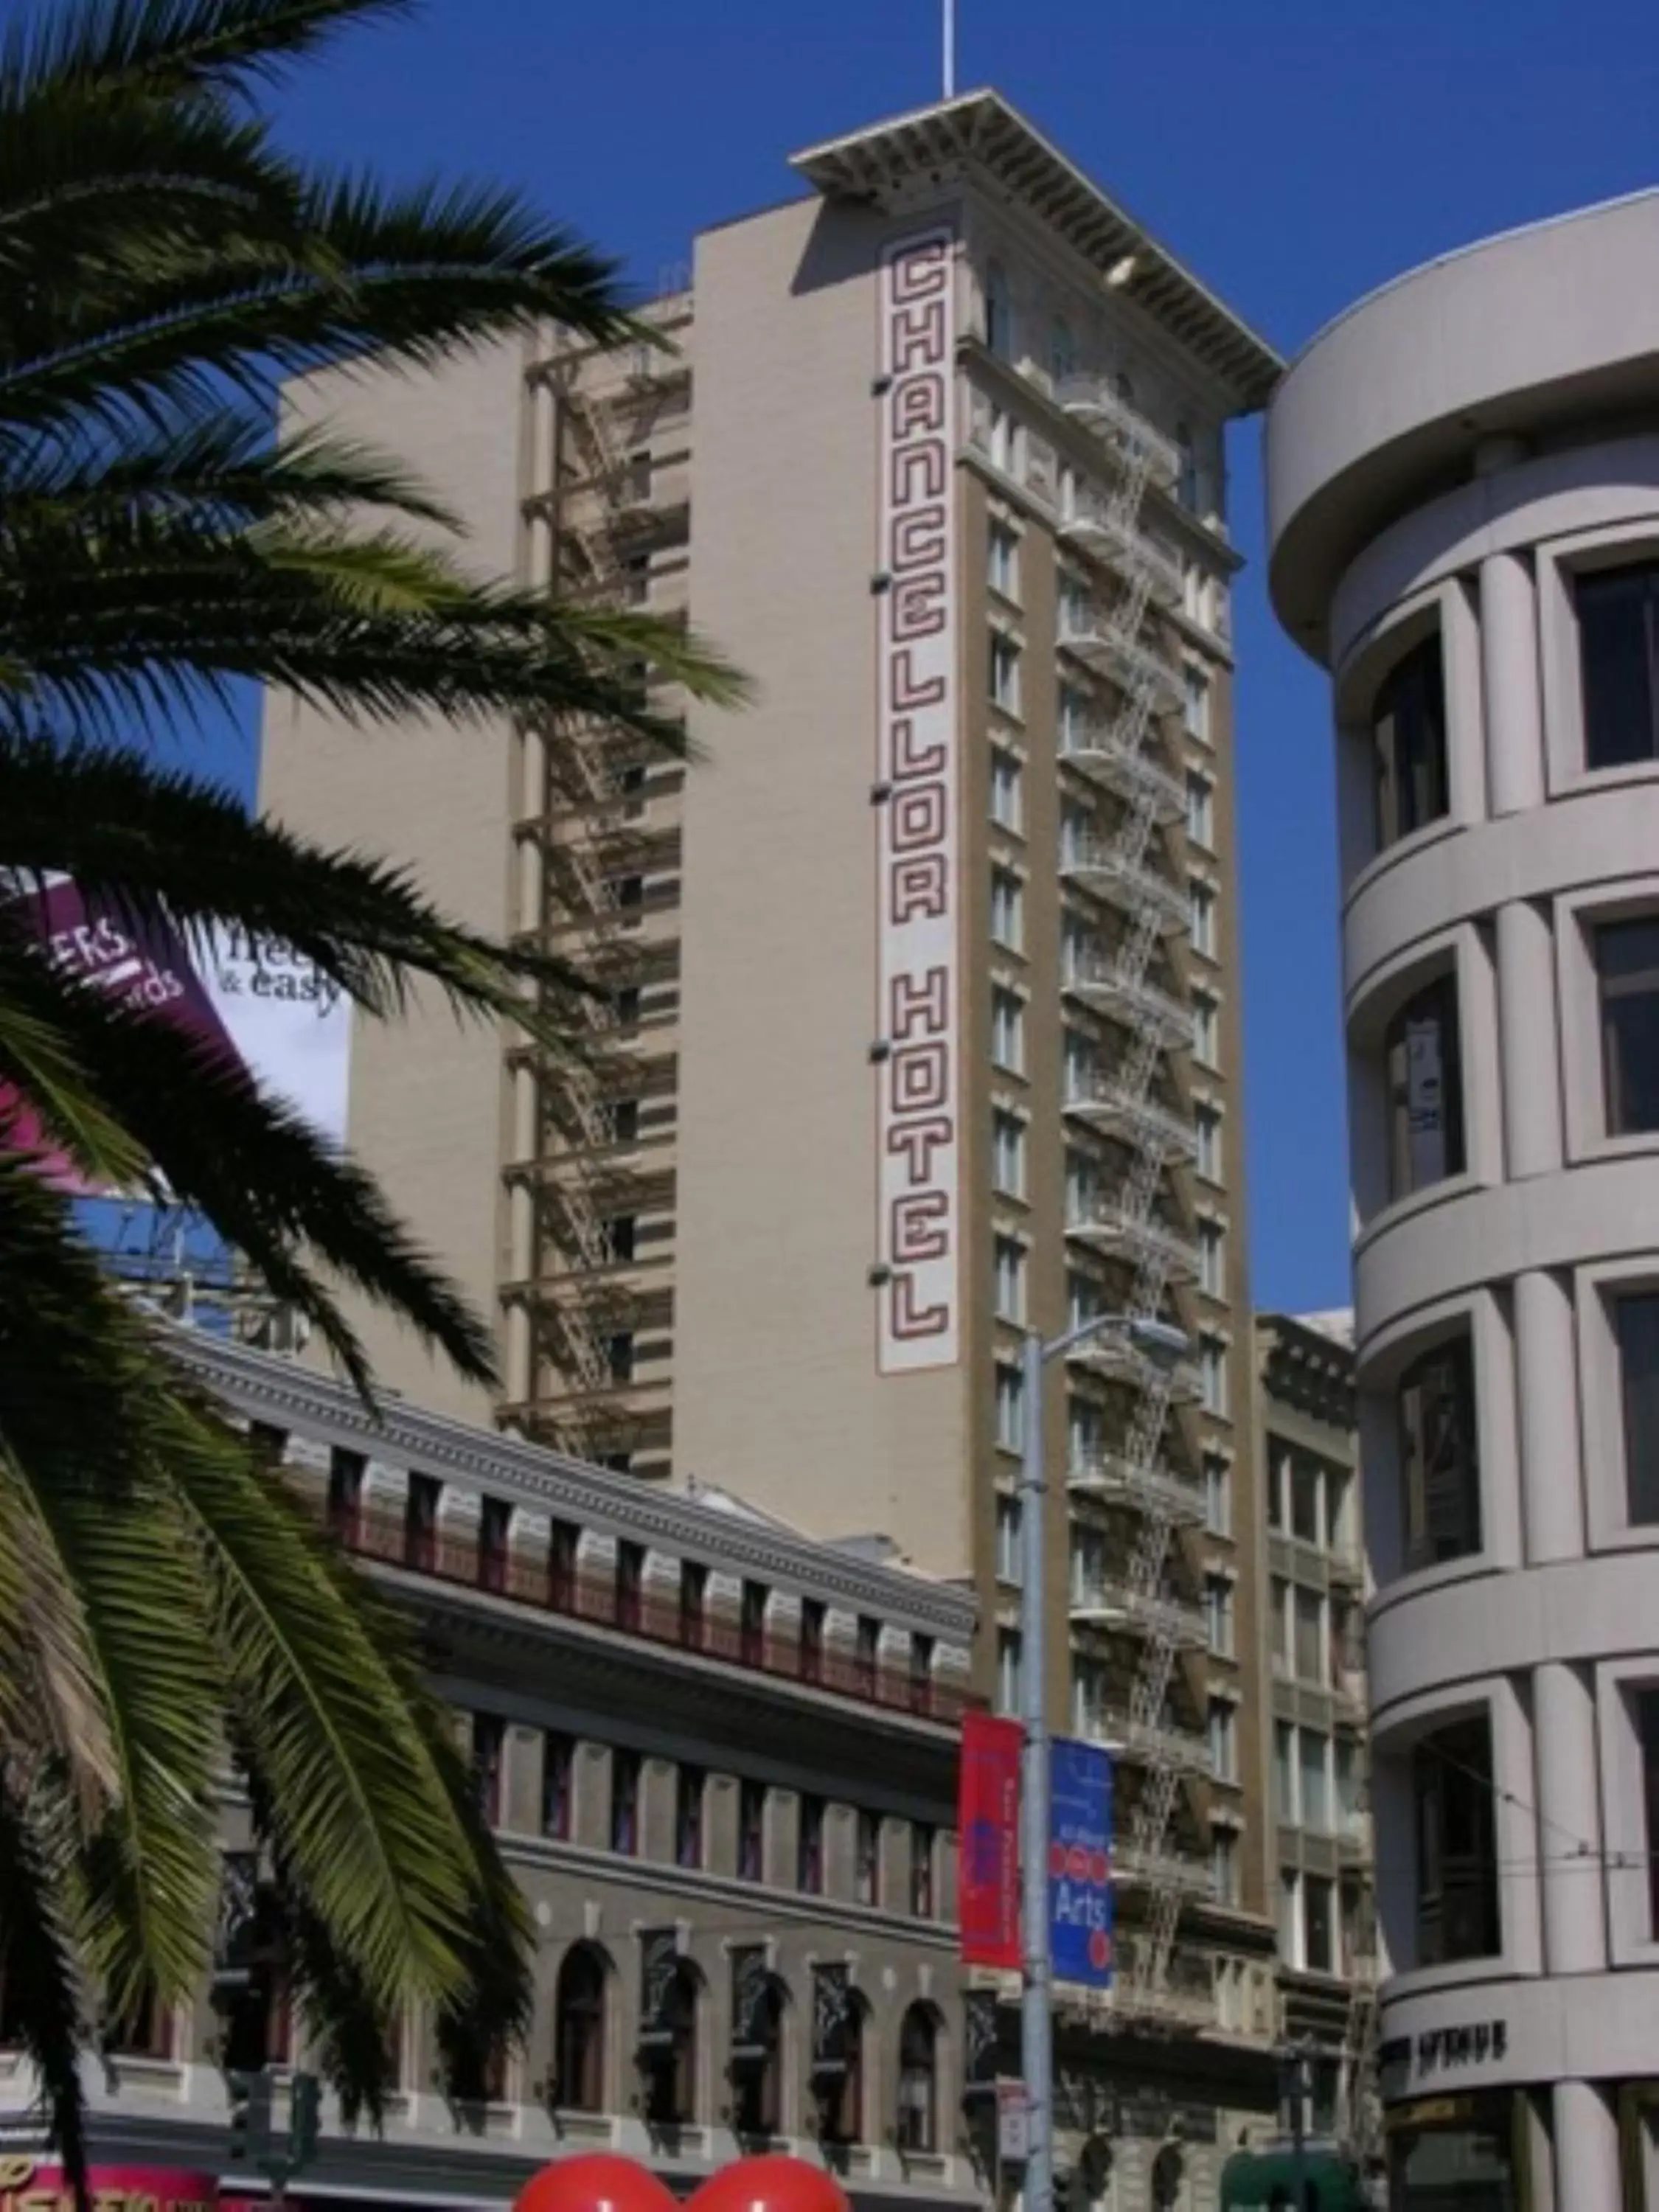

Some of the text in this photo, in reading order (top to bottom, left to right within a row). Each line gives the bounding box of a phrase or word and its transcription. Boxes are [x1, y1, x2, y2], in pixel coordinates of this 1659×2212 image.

[251, 964, 341, 1019] easy
[887, 237, 953, 1340] CHANCELLOR HOTEL
